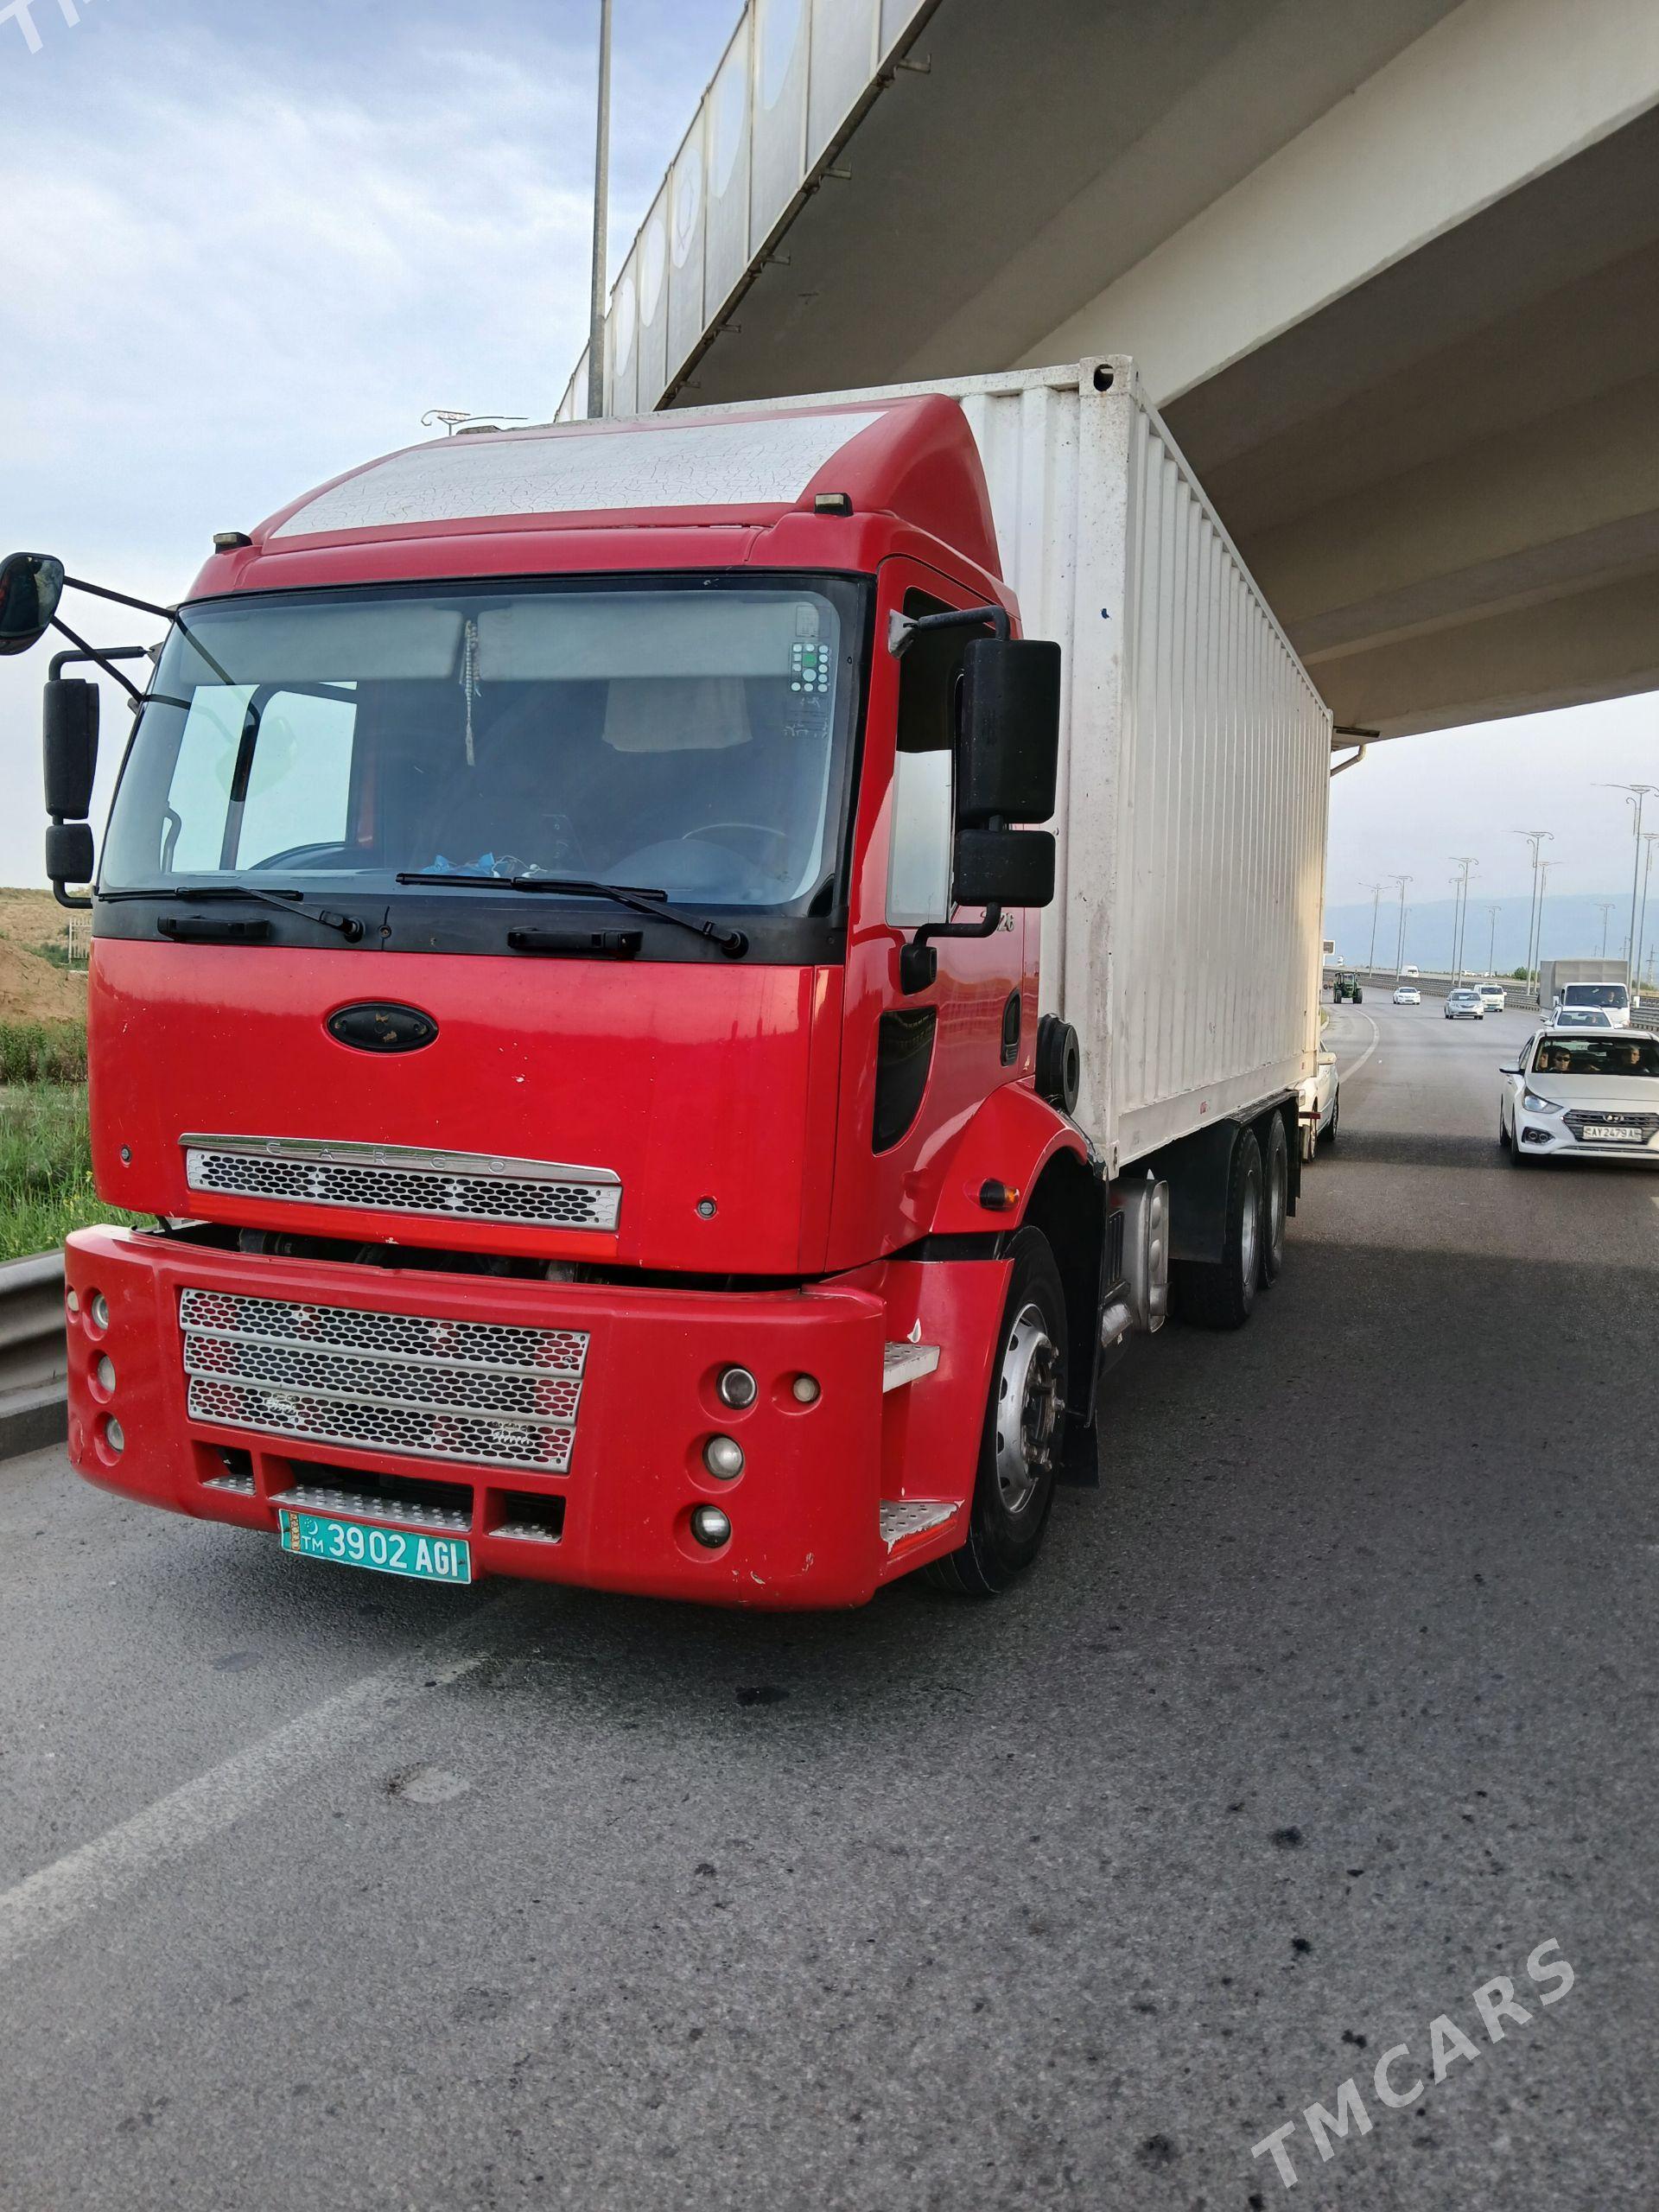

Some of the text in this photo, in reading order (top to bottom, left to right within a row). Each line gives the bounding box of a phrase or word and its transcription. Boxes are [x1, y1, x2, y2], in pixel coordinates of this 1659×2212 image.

[266, 1142, 505, 1174] CARGO
[301, 1535, 324, 1554] TM
[327, 1523, 408, 1569] 3902
